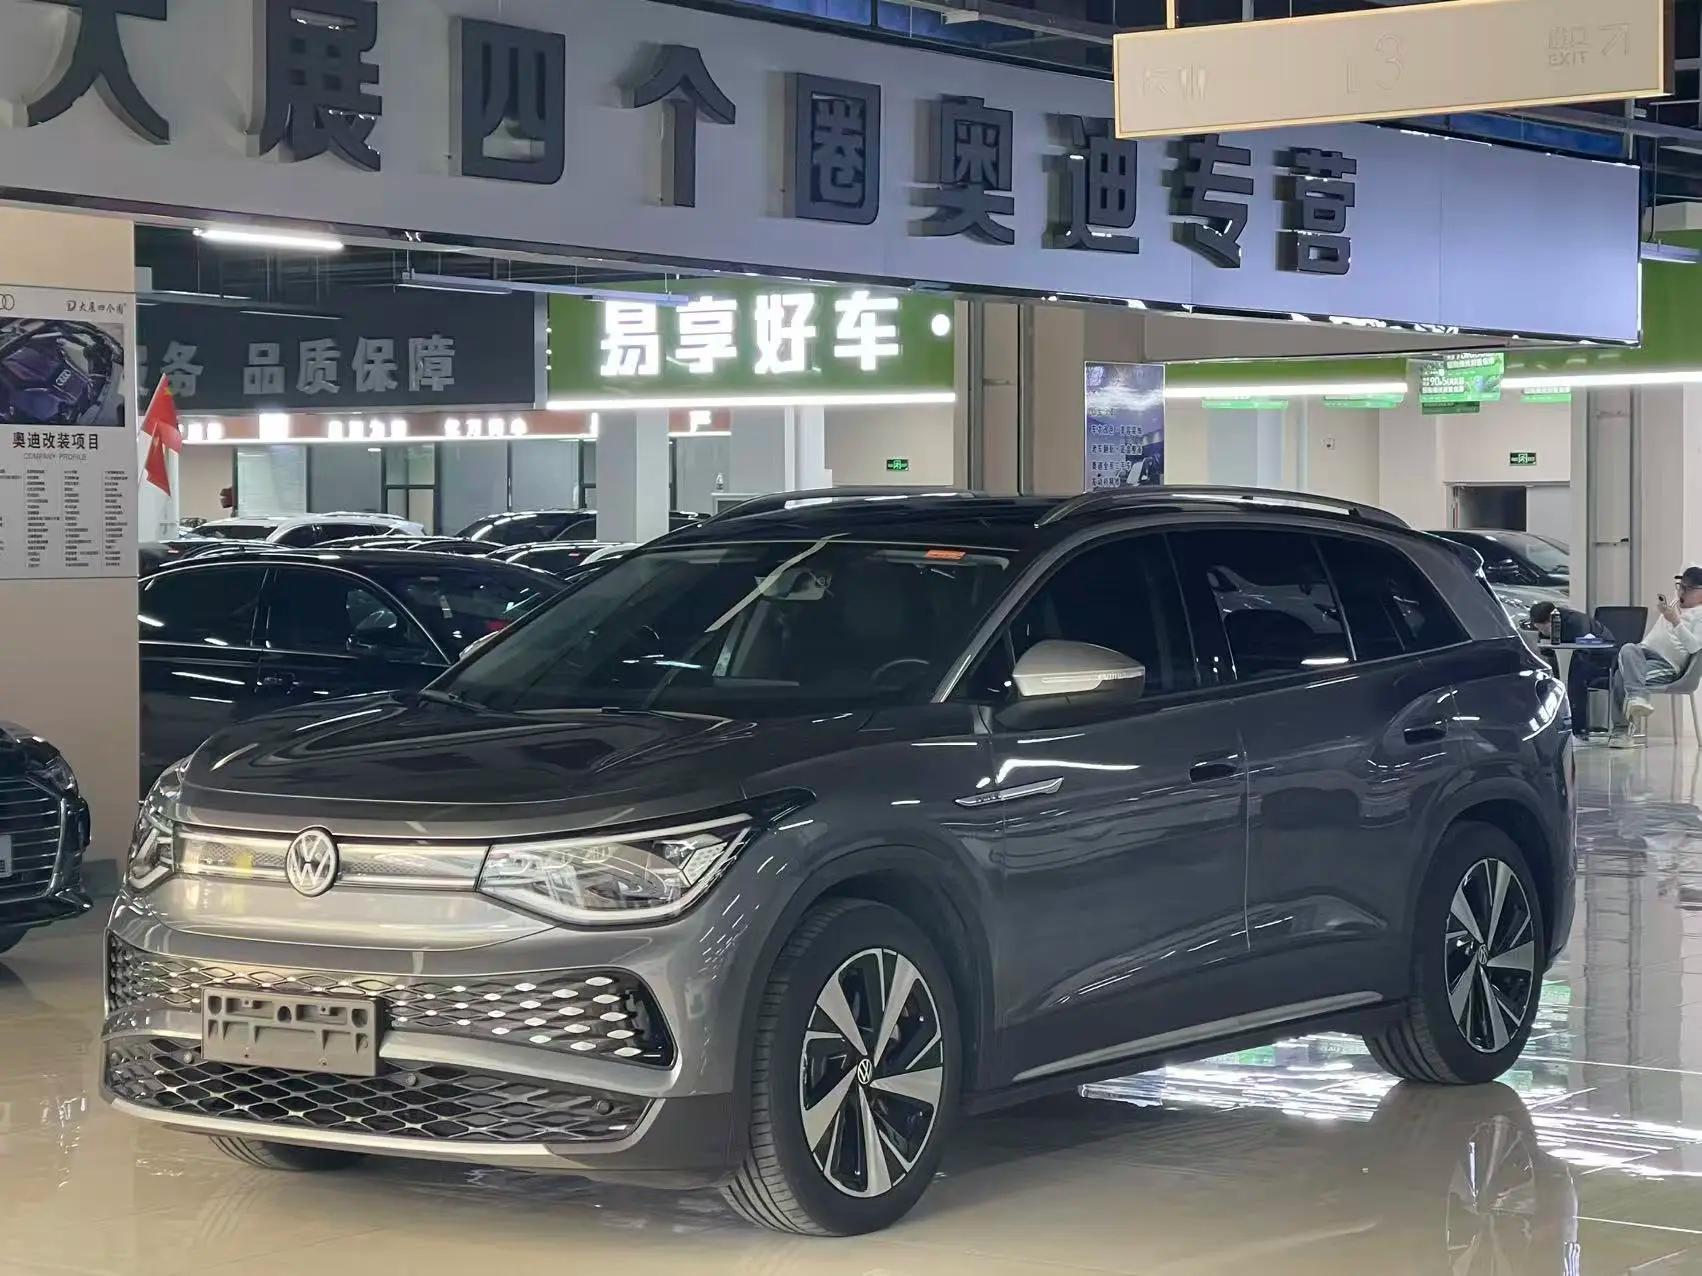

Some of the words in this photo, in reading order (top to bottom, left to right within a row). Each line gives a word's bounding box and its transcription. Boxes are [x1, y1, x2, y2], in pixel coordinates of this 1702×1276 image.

[1548, 51, 1588, 65] EXIT
[599, 290, 901, 376] 易享好车
[242, 334, 455, 395] 品质保障
[13, 432, 98, 450] 奥迪改装项目
